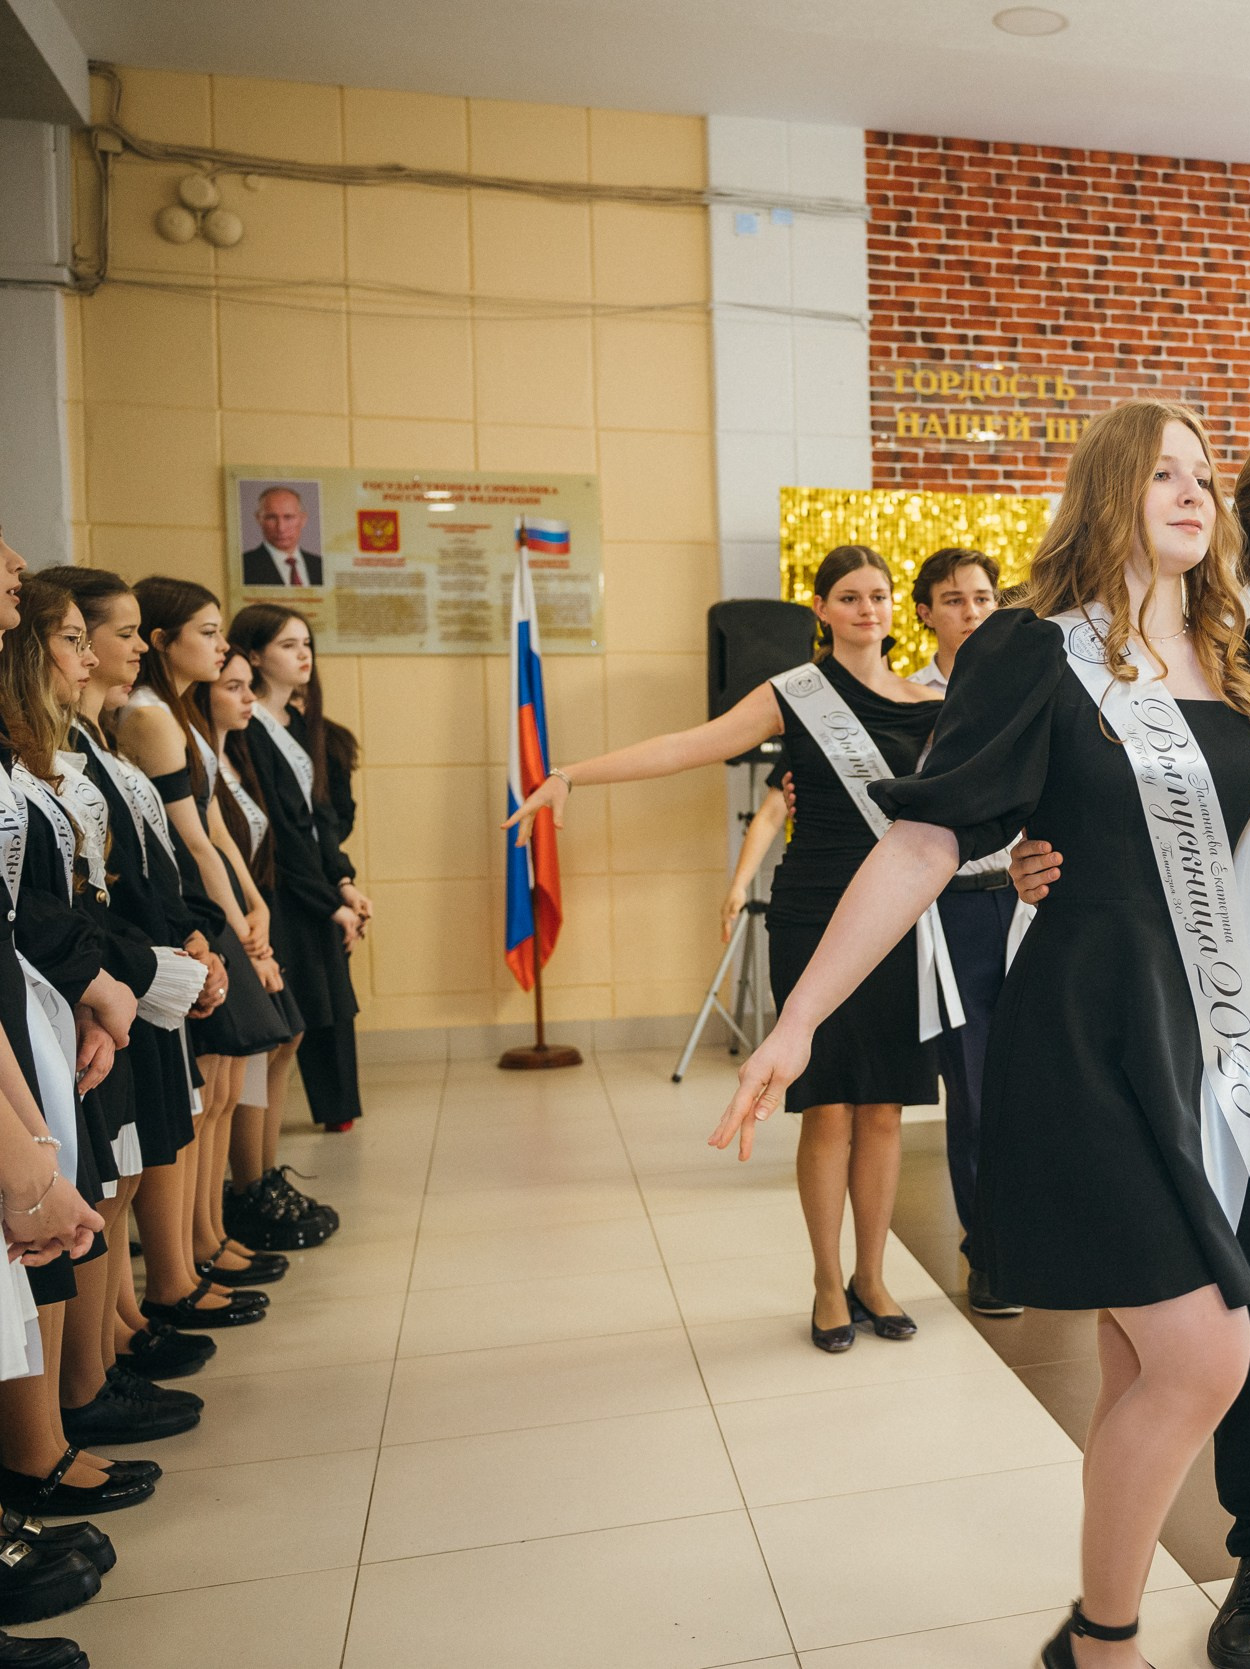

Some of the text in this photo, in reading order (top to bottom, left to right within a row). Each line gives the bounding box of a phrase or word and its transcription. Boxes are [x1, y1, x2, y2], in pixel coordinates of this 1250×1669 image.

[895, 369, 1076, 401] ГОРДОСТЬ
[896, 411, 1090, 443] НАШЕЙ Ш
[1131, 698, 1218, 959] Выпускница
[1210, 861, 1233, 943] Екатерина
